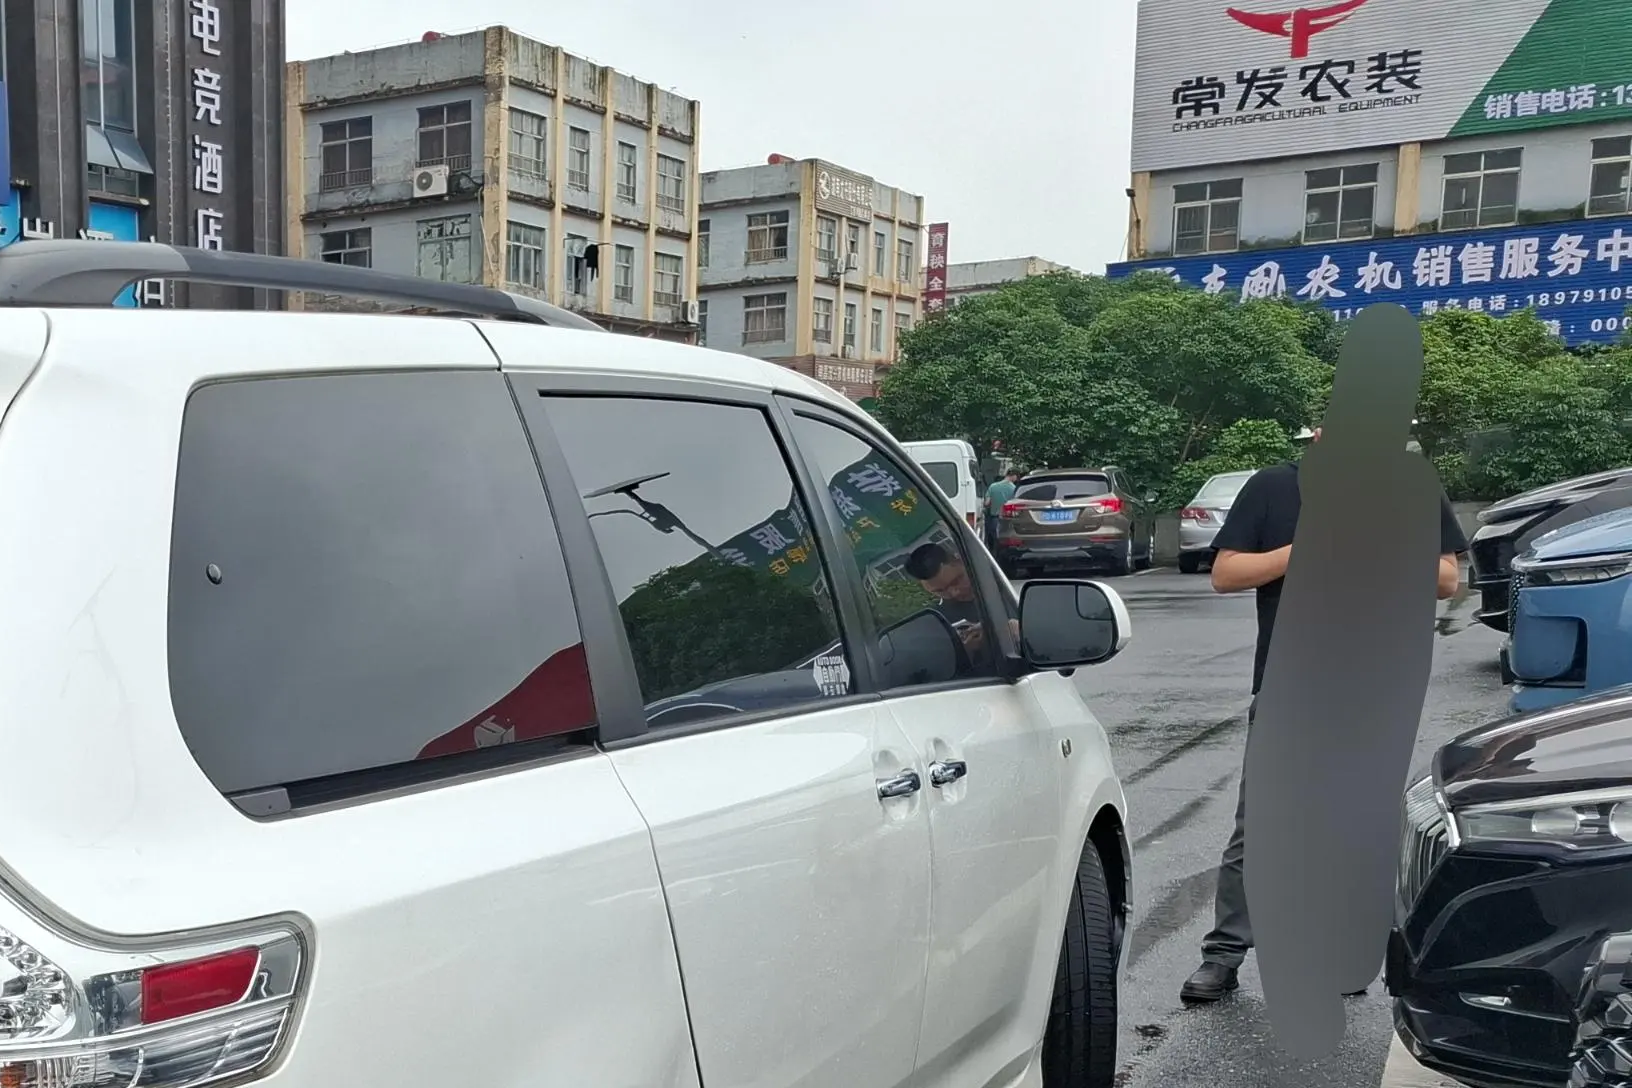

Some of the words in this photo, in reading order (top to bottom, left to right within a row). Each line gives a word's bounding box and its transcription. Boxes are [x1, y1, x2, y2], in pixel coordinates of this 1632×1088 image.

[1172, 50, 1423, 119] 常发农装
[1172, 116, 1233, 133] CHANGFA
[1234, 105, 1328, 126] AGRICULTURAL
[1338, 93, 1422, 113] EQUIPMENT
[192, 0, 223, 250] 电竞酒店
